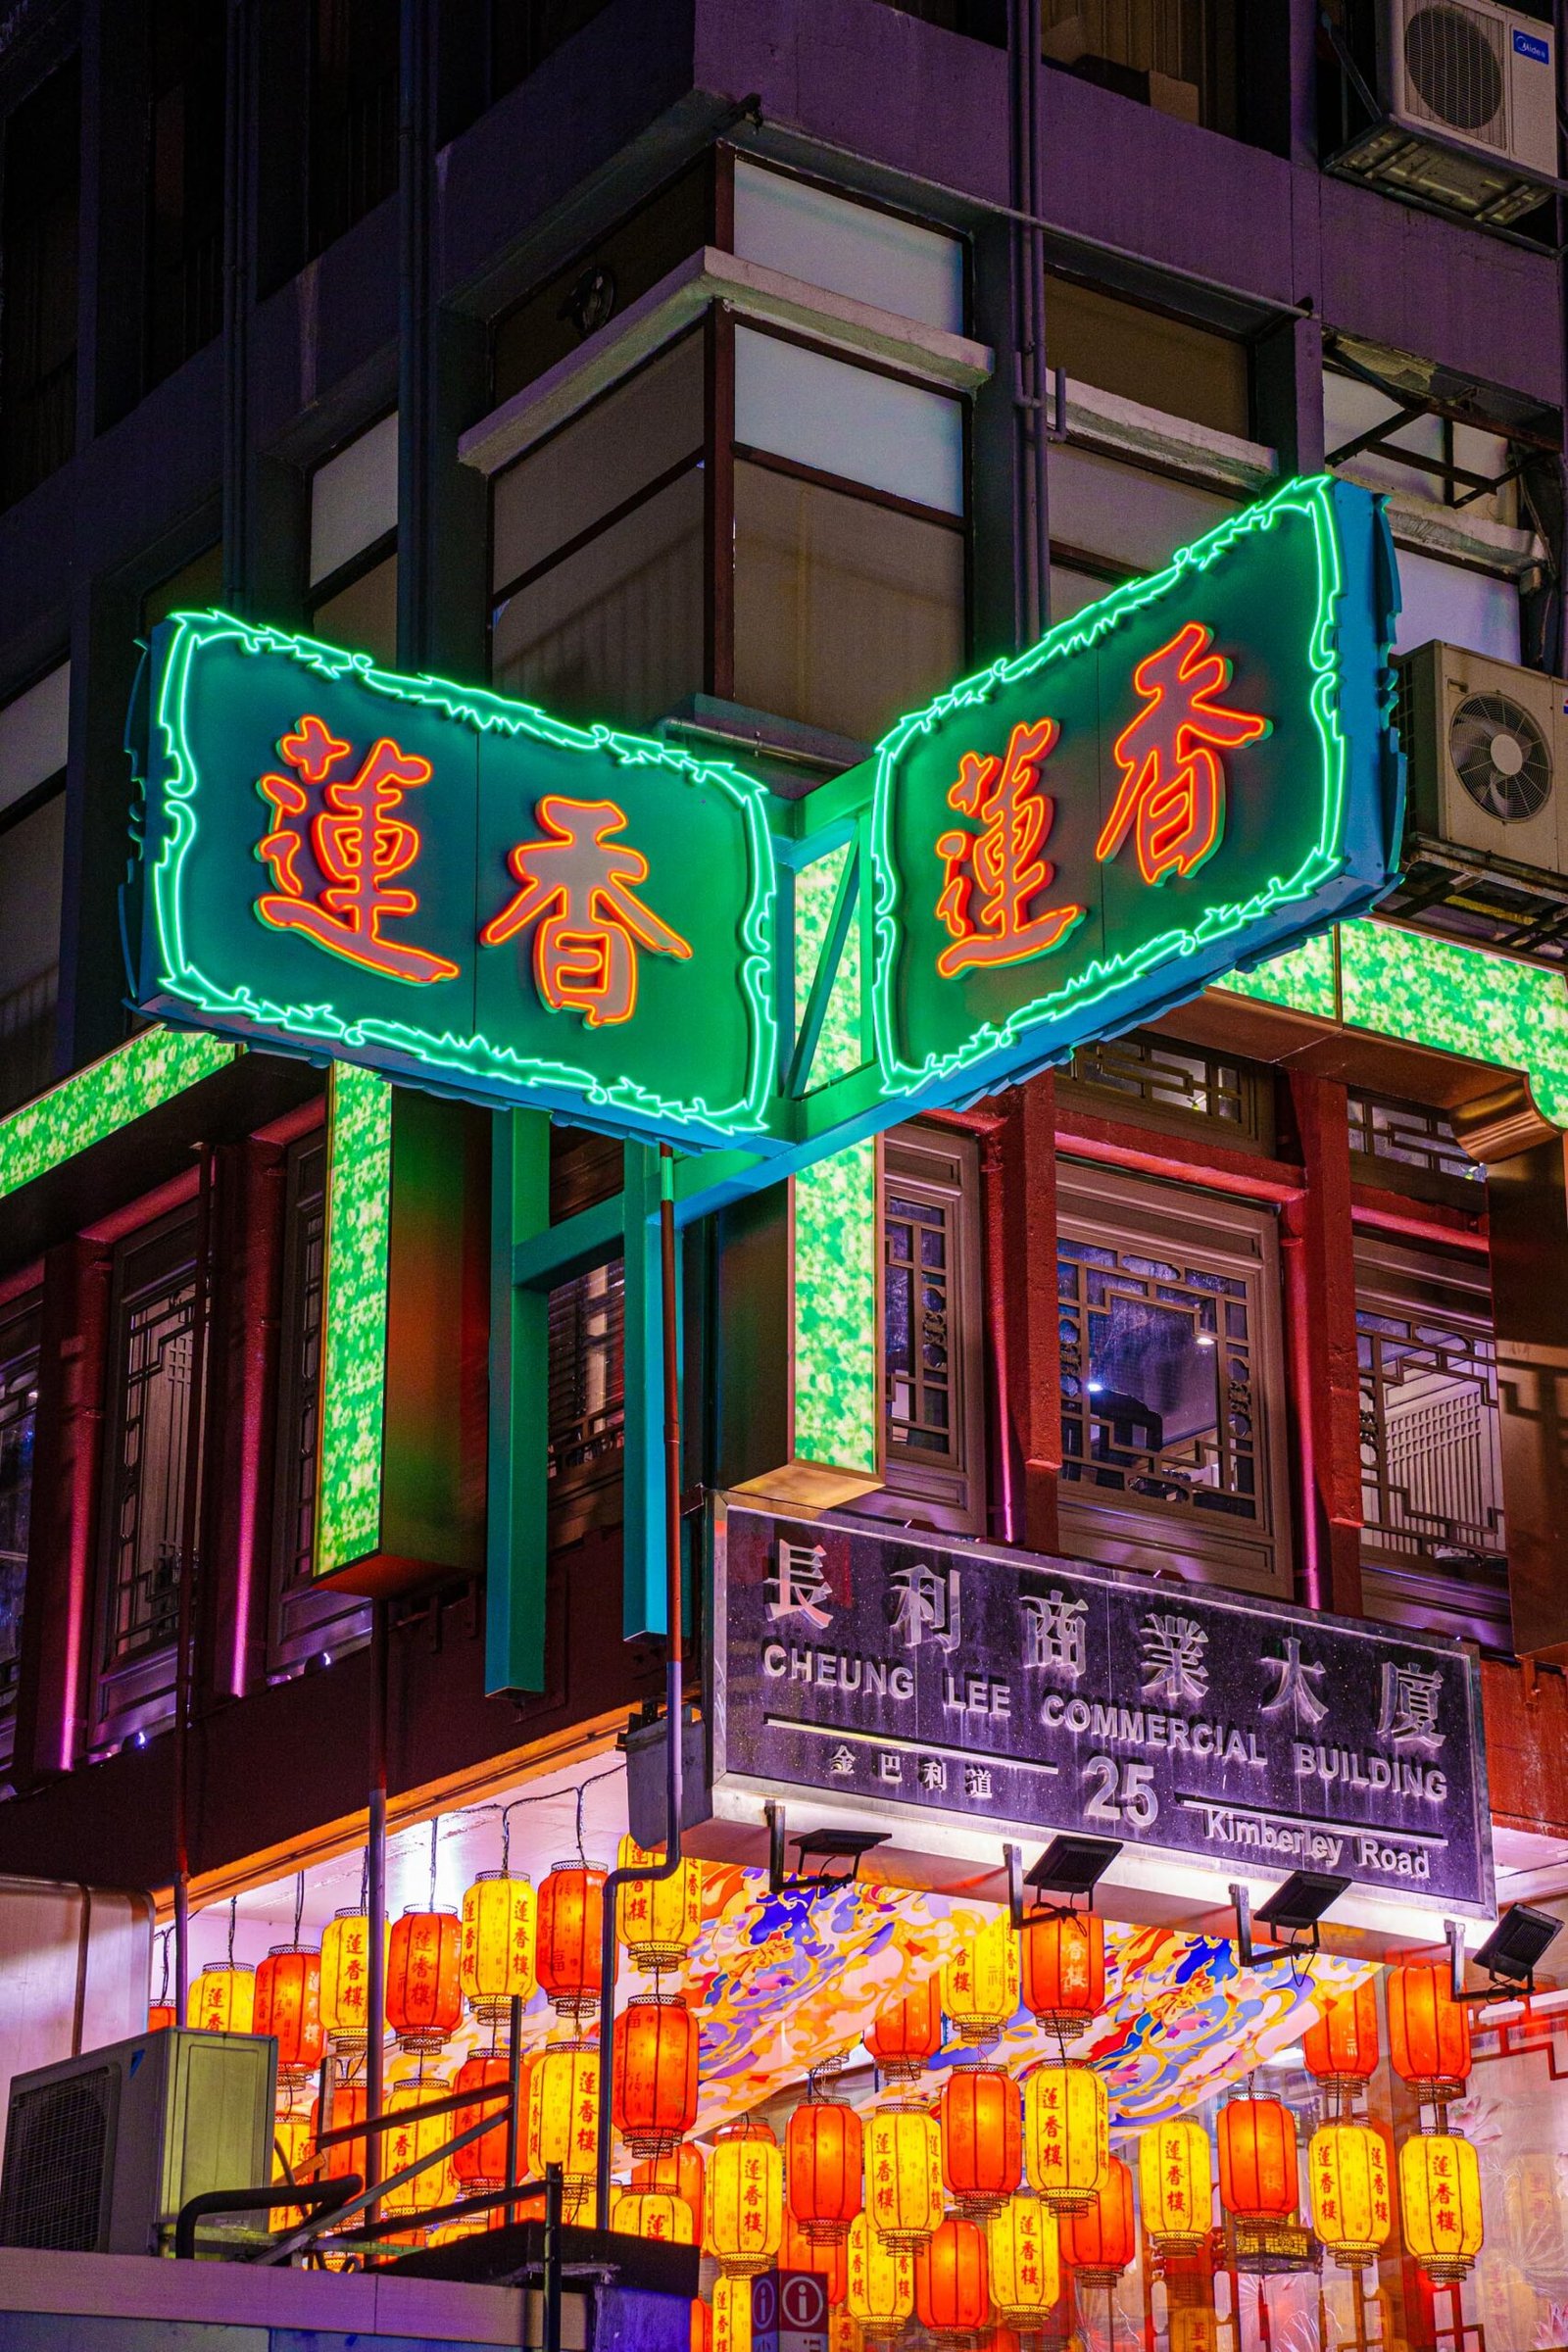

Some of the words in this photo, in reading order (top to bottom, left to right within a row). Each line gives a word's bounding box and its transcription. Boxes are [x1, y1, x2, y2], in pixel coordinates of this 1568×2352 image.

[935, 621, 1267, 979] 蓮香
[255, 715, 692, 1028] 蓮香
[763, 1539, 1446, 1747] 長利商業大廈
[762, 1643, 914, 1700] CHEUNG
[944, 1675, 1011, 1718] LEE
[1042, 1694, 1268, 1765] COMMERCIAL
[1294, 1742, 1447, 1801] BUILDING
[829, 1744, 992, 1799] 金巴利道
[1084, 1755, 1158, 1827] 25
[1204, 1807, 1343, 1866] Kimberley
[1357, 1838, 1430, 1879] Road
[345, 1934, 366, 2007] 蓮香樓
[513, 1898, 530, 1977] 蓮香樓
[577, 2071, 597, 2152] 蓮香樓
[1042, 2087, 1062, 2168] 蓮香樓
[743, 2159, 762, 2232] 蓮香樓
[876, 2132, 894, 2209] 蓮香樓
[1164, 2140, 1185, 2212] 蓮香樓
[1317, 2146, 1337, 2222] 蓮香樓
[1371, 2147, 1388, 2224] 蓮香樓
[1431, 2155, 1458, 2232] 蓮香樓
[1019, 2216, 1038, 2286] 蓮香樓
